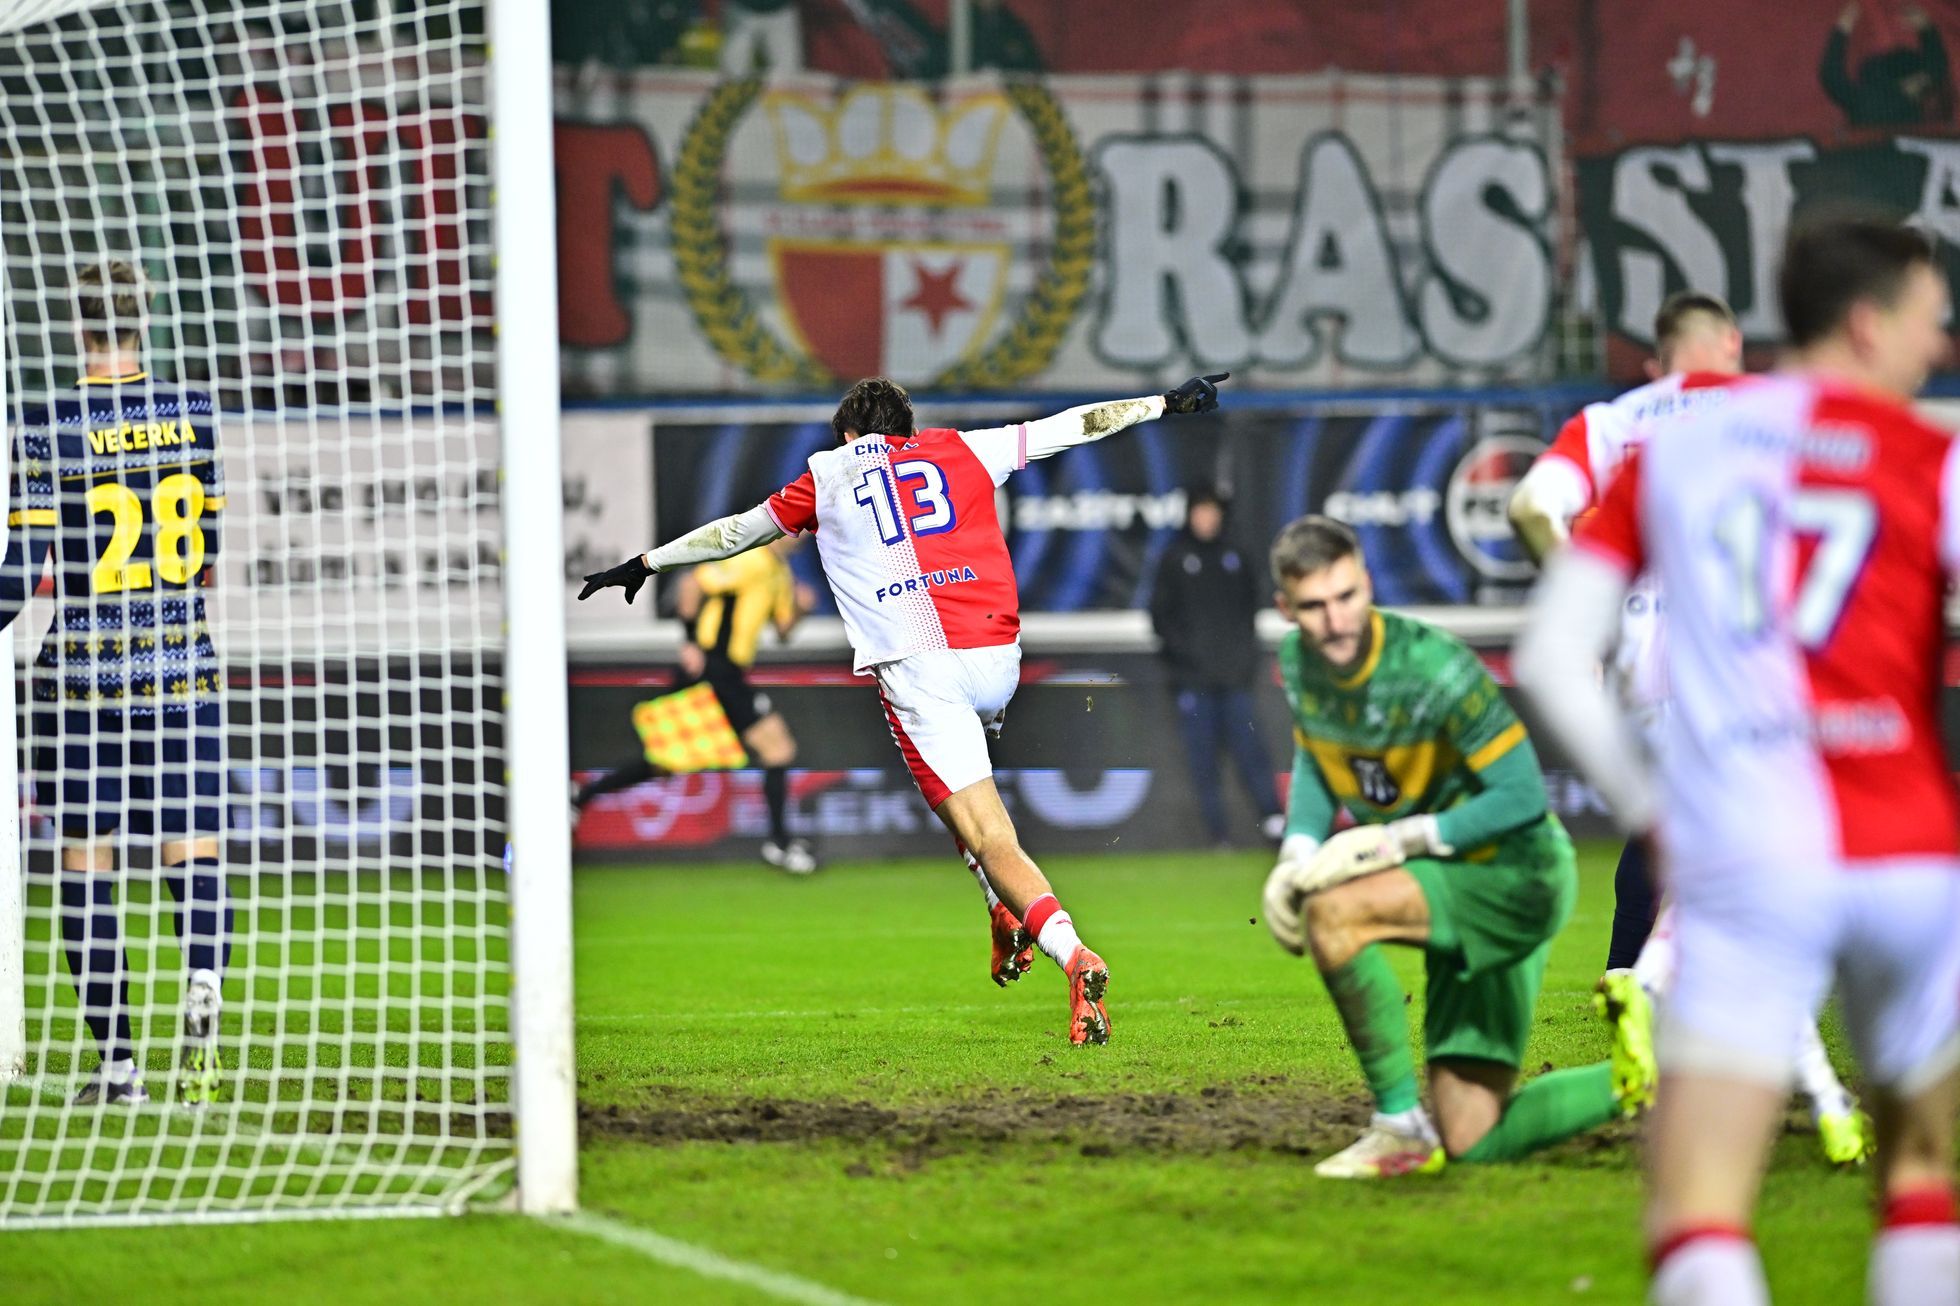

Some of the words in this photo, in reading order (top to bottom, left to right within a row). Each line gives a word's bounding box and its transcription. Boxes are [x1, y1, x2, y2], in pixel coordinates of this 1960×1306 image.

[1096, 138, 1550, 362] RAS
[88, 419, 197, 455] VEČERKA
[85, 473, 206, 594] 28
[853, 459, 957, 546] 13
[876, 566, 978, 603] FORTUNA
[1710, 490, 1884, 654] 17
